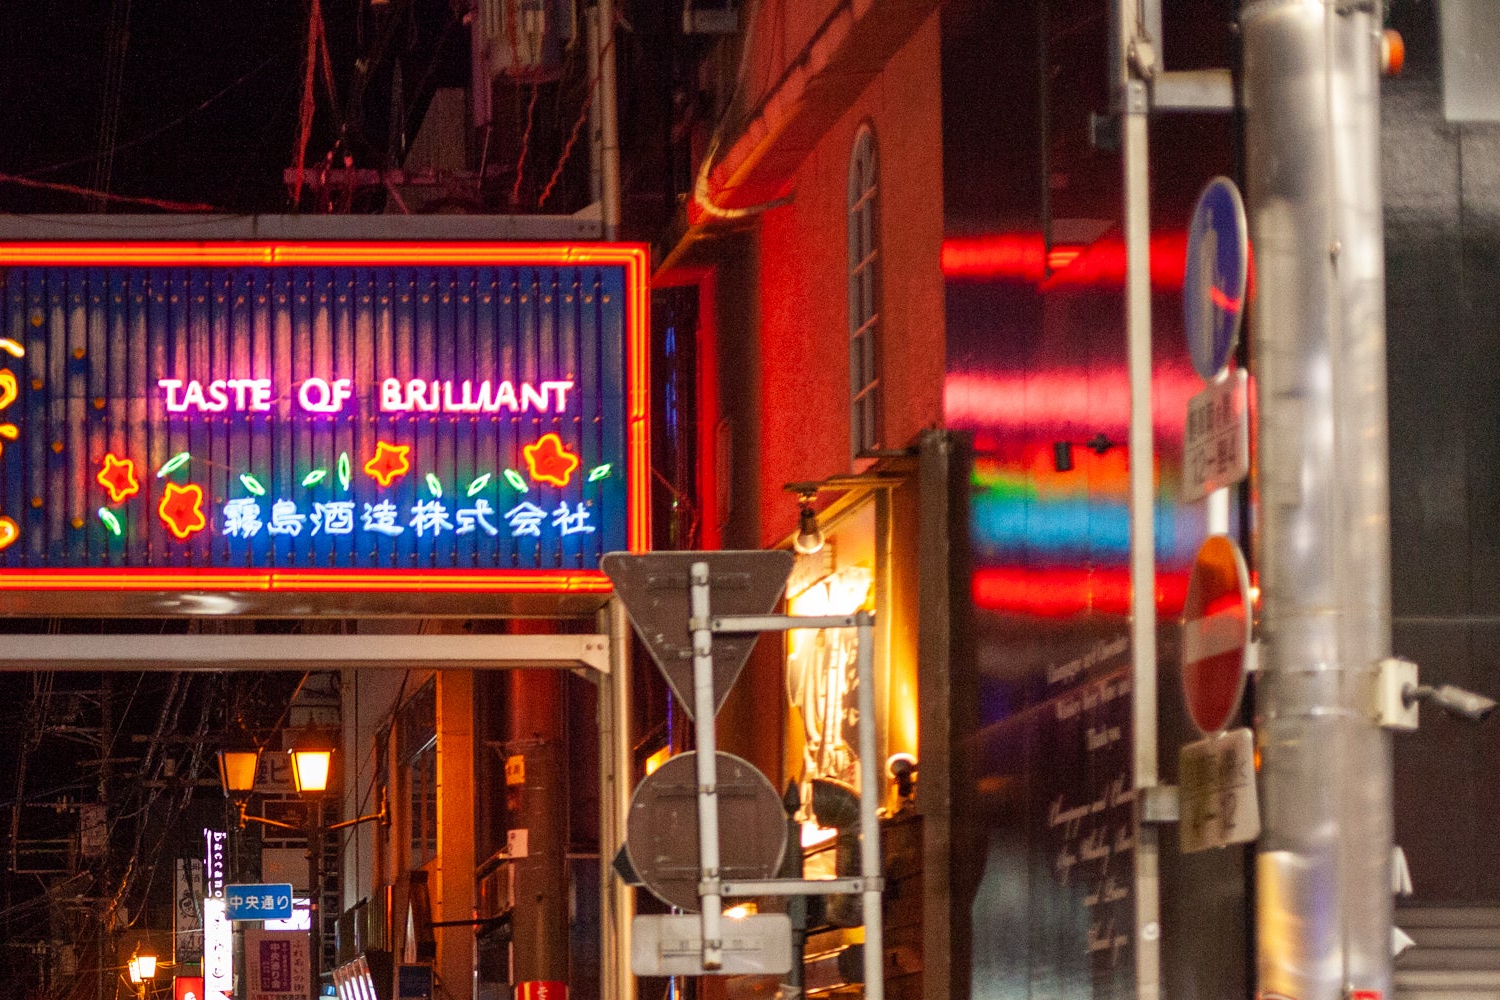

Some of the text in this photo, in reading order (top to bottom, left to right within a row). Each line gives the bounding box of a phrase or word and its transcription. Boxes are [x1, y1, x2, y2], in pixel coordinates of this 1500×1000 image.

[157, 378, 575, 413] TASTE OF BRILLIANT
[222, 497, 597, 538] 霧島酒造株式会社
[229, 895, 290, 910] 中央通り
